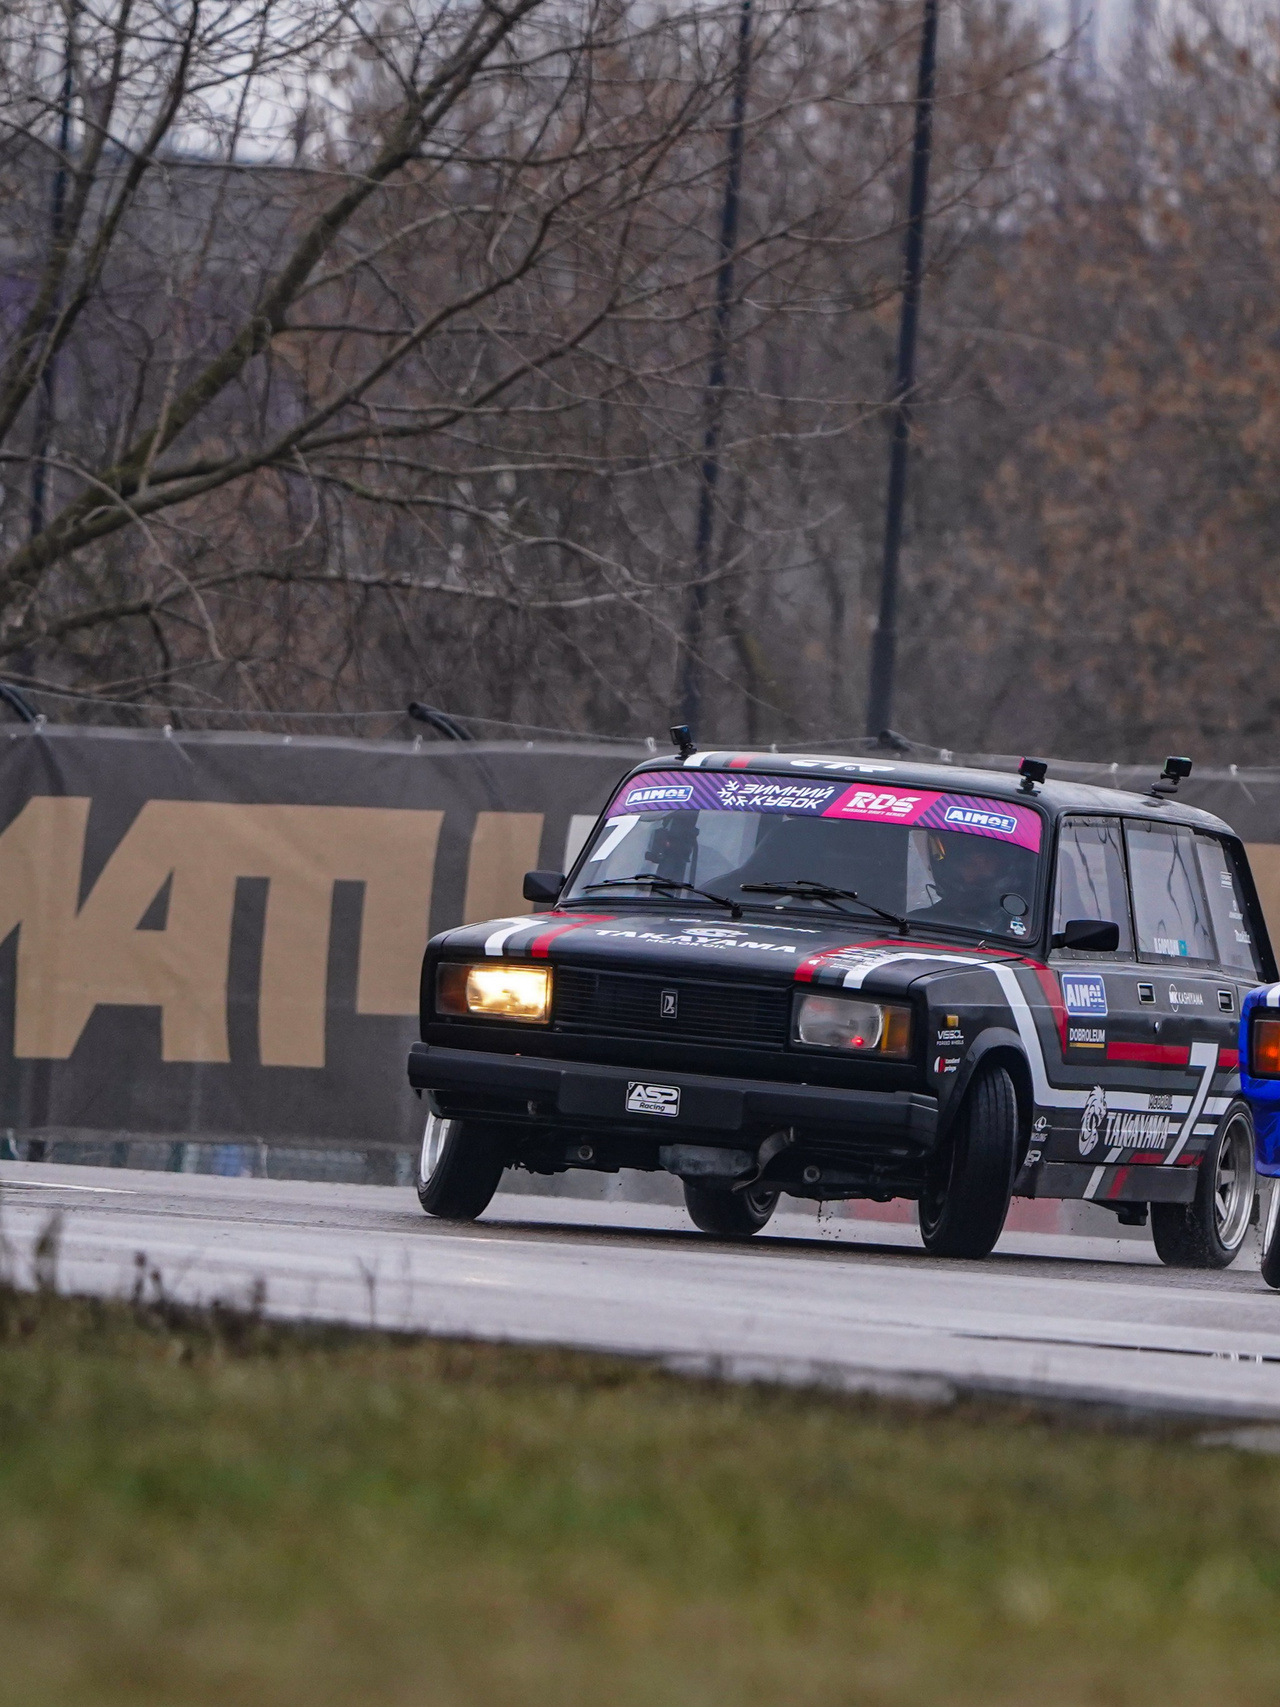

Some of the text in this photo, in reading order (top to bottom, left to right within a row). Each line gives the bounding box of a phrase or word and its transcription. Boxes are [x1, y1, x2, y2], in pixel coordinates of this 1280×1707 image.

[627, 787, 688, 804] AIMOL
[738, 783, 835, 799] ЗИМНИЙ
[749, 795, 825, 809] КУБОК
[846, 791, 921, 813] RDS
[947, 809, 1012, 830] AIMOL
[594, 929, 797, 953] TAKAYAMA
[1066, 983, 1105, 1008] AIMOL
[1069, 1027, 1106, 1042] DOBROLEUM
[629, 1085, 678, 1103] ASP
[1164, 1042, 1218, 1165] 7
[639, 1102, 666, 1112] Racing
[1103, 1112, 1171, 1150] TAKAYAMA
